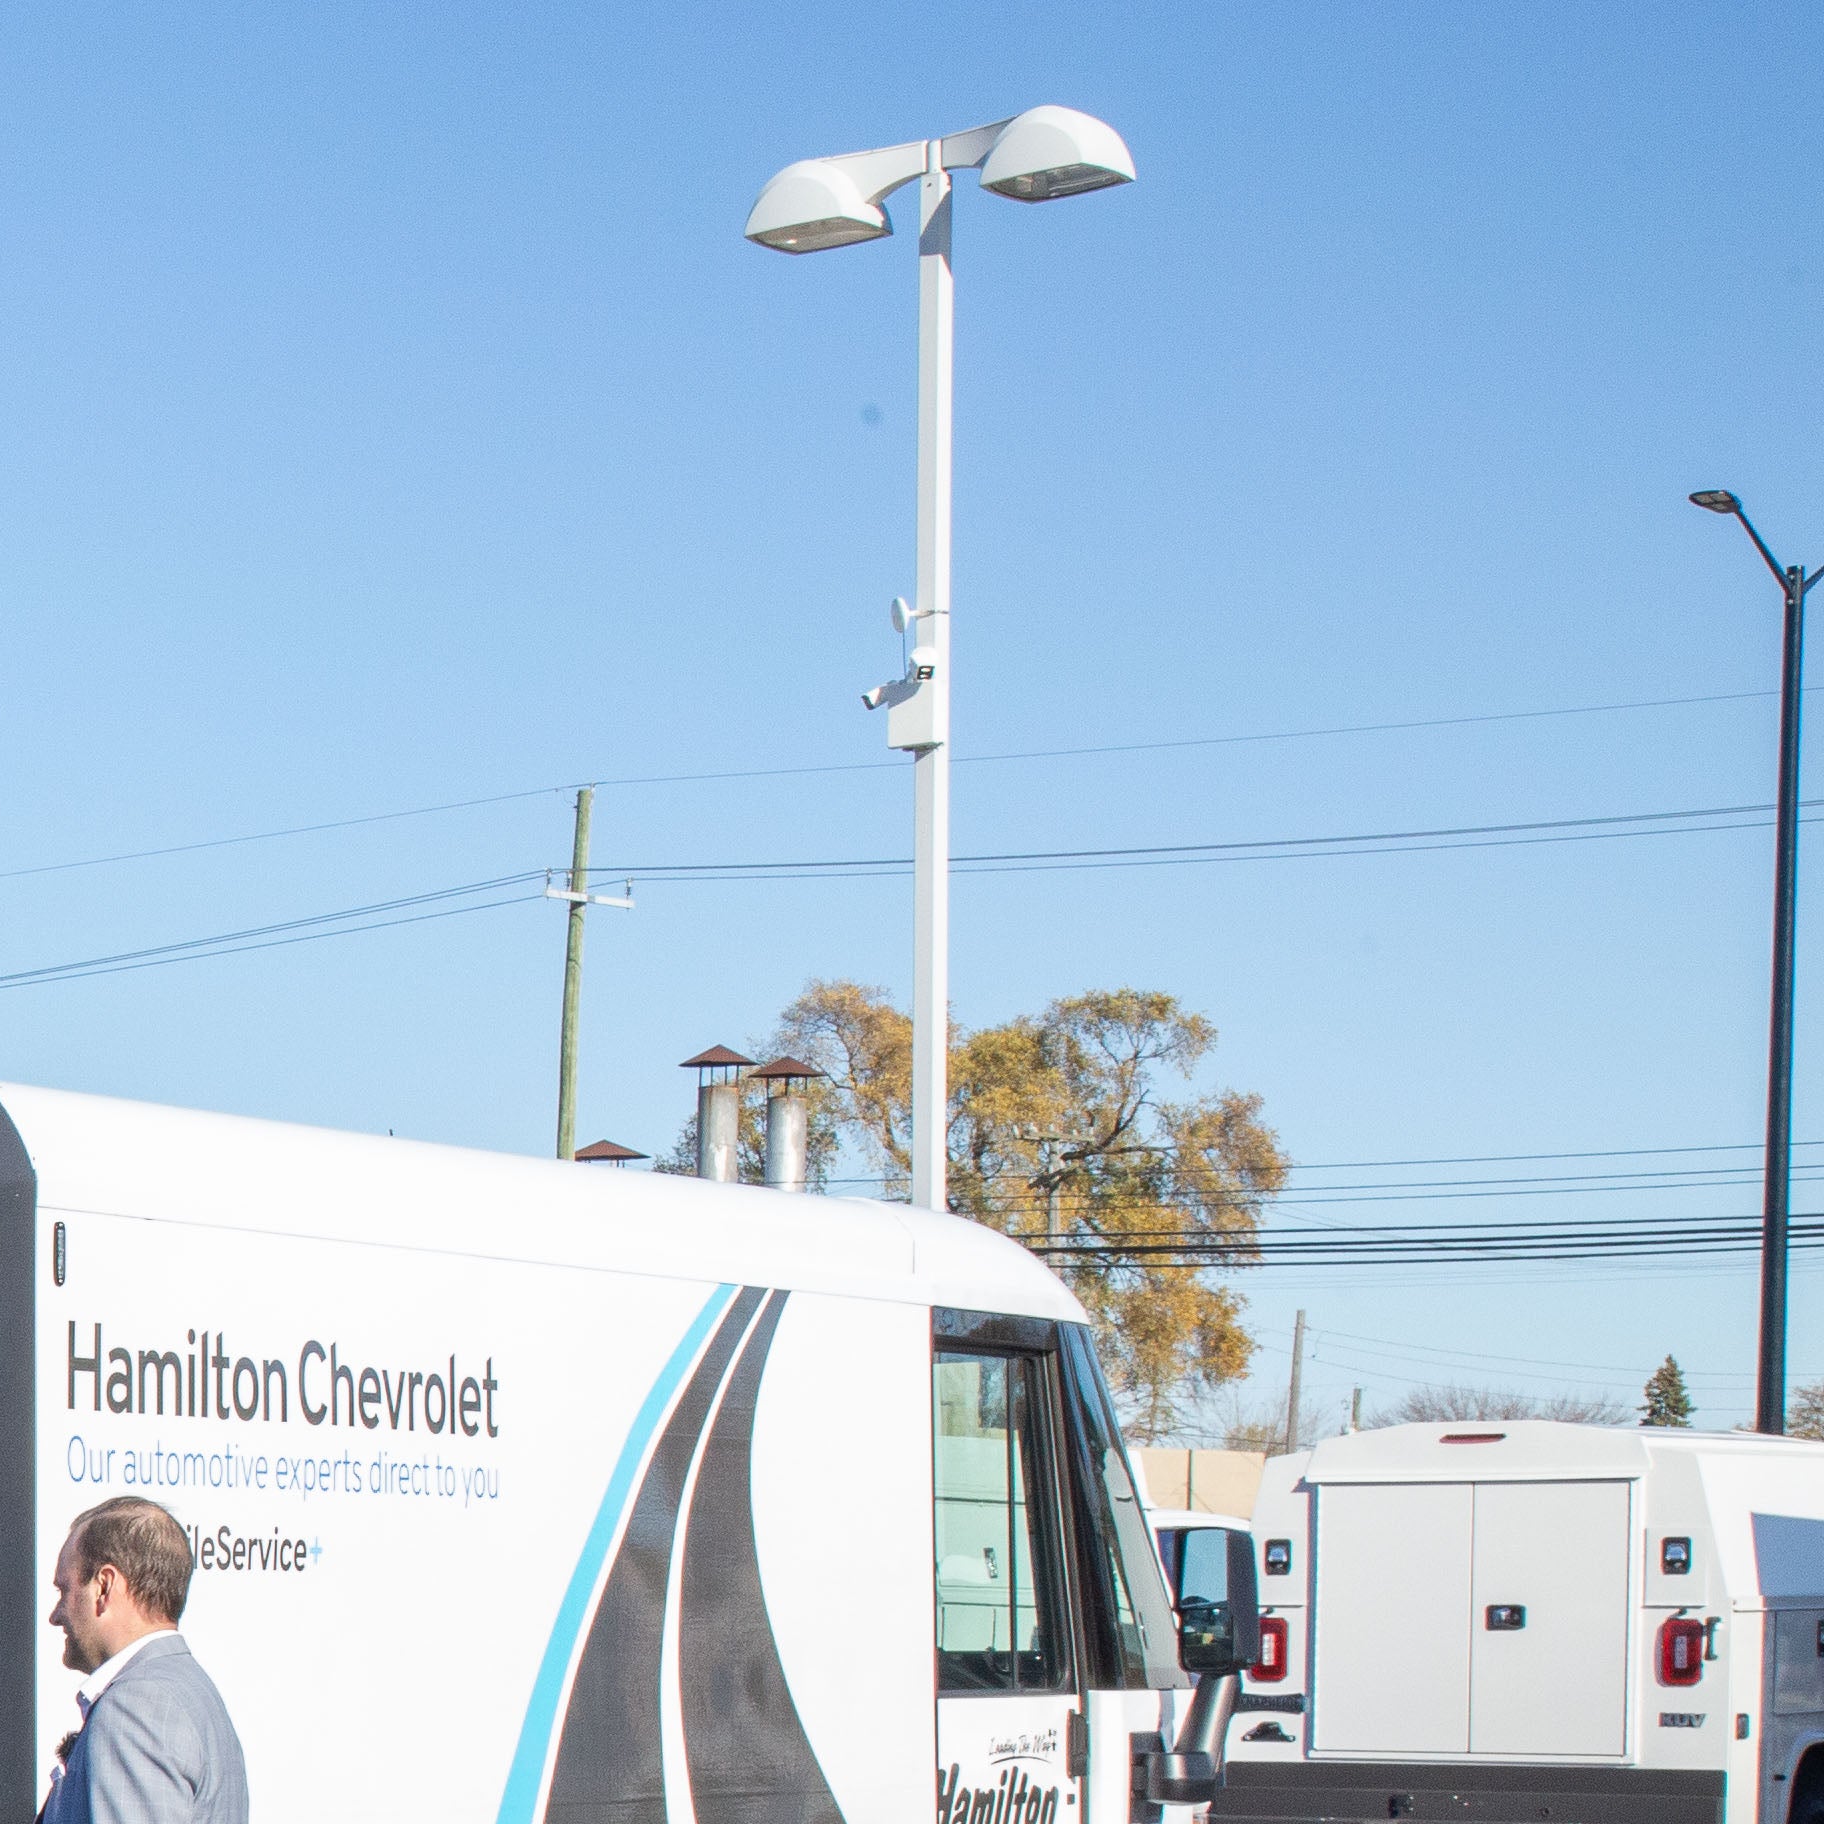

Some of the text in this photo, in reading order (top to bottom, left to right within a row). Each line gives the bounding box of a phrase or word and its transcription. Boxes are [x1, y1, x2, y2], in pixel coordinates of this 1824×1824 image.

[67, 1320, 499, 1438] Hamilton Chevrolet
[67, 1435, 499, 1508] Our automotive experts direct to you
